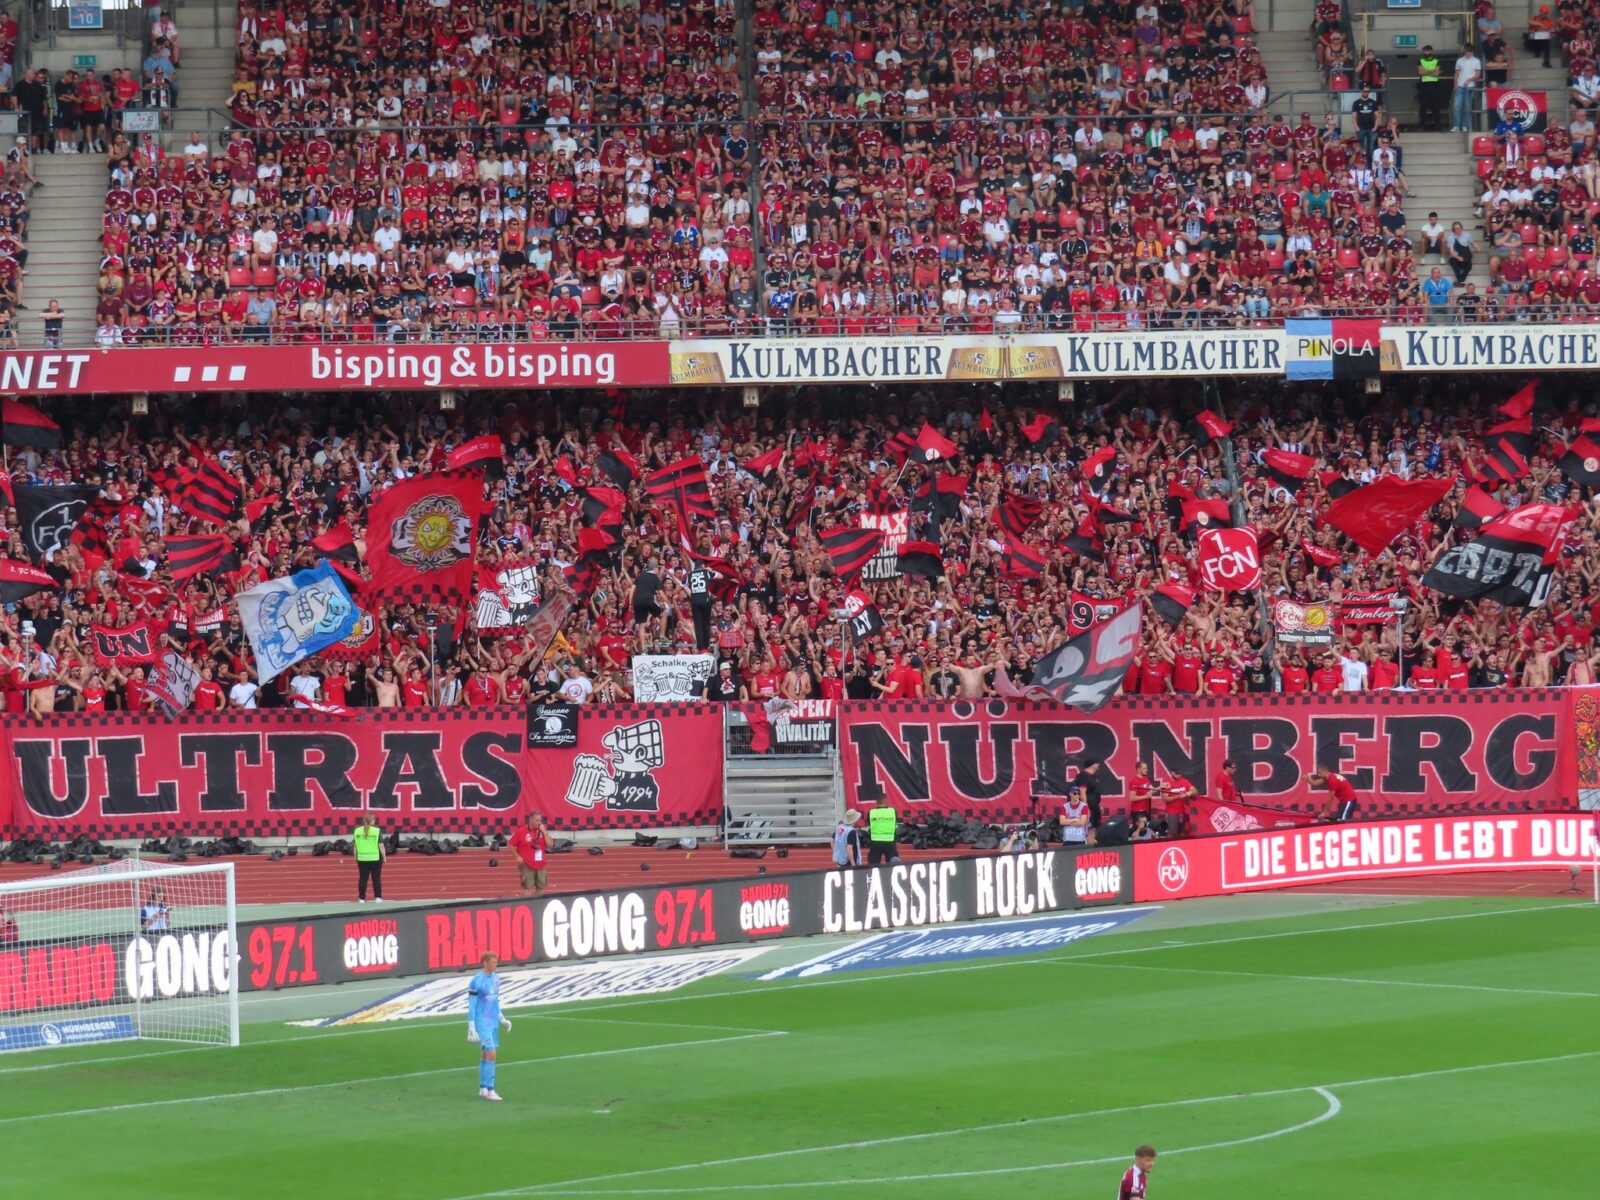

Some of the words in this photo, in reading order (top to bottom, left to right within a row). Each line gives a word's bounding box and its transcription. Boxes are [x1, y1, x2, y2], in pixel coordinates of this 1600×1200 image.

[729, 343, 942, 378] KULMBACHER
[1068, 336, 1281, 371] KULMBACHER
[1298, 338, 1374, 357] PINOLA
[2, 355, 90, 390] NET
[312, 347, 441, 386] bisping
[450, 346, 477, 377] &
[484, 346, 616, 384] bisping
[670, 365, 720, 382] KULMBACHER
[1009, 358, 1057, 376] KULMBACHER
[861, 512, 907, 534] MAX
[1211, 532, 1231, 554] 1.
[862, 558, 902, 579] STADI
[1204, 545, 1258, 583] FCN
[651, 660, 687, 668] Schalke
[776, 721, 832, 743] RIVALITÄT
[848, 698, 1556, 802] NÜRNBERG
[13, 731, 522, 819] ULTRAS
[621, 786, 653, 802] 1994
[1245, 837, 1285, 878] DIE
[1295, 823, 1419, 872] LEGENDE
[1434, 821, 1518, 861] LEBT
[1075, 865, 1121, 896] GONG
[1161, 864, 1185, 881] FCN
[822, 860, 957, 933] CLASSIC
[976, 851, 1056, 916] ROCK
[426, 904, 534, 969] RADIO
[542, 892, 647, 959] GONG
[654, 888, 717, 948] 97.1
[740, 898, 790, 930] GONG
[0, 941, 117, 1011] RADIO
[125, 930, 241, 1000] GONG
[249, 924, 319, 988] 97.1
[344, 934, 399, 968] GONG
